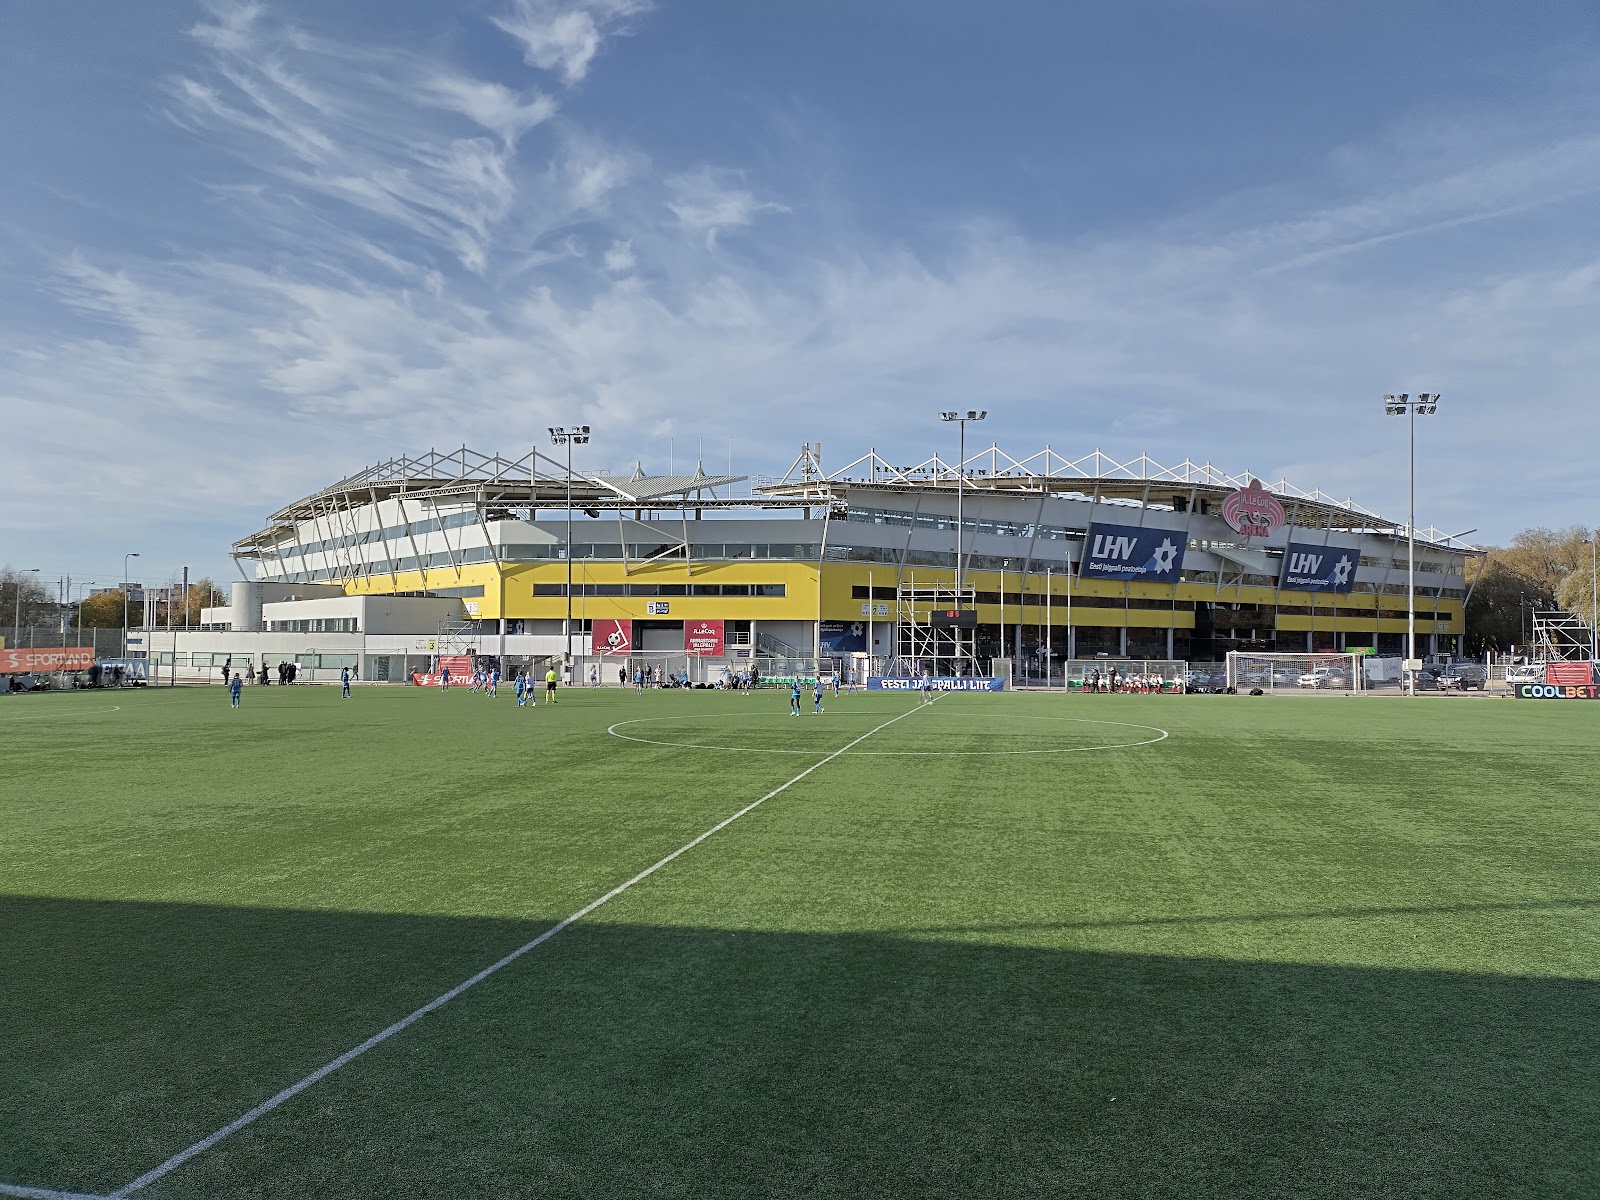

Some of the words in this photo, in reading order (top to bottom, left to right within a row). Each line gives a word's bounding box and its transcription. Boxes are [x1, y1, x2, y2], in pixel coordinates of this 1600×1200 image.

[1240, 523, 1270, 537] ARENA
[1092, 534, 1138, 560] LHV
[1289, 552, 1323, 574] LHV
[429, 642, 435, 650] 3
[26, 653, 91, 666] SPORTLAND
[881, 680, 909, 689] EESTI
[912, 679, 967, 692] JAGPALLI
[969, 680, 991, 690] LIIT
